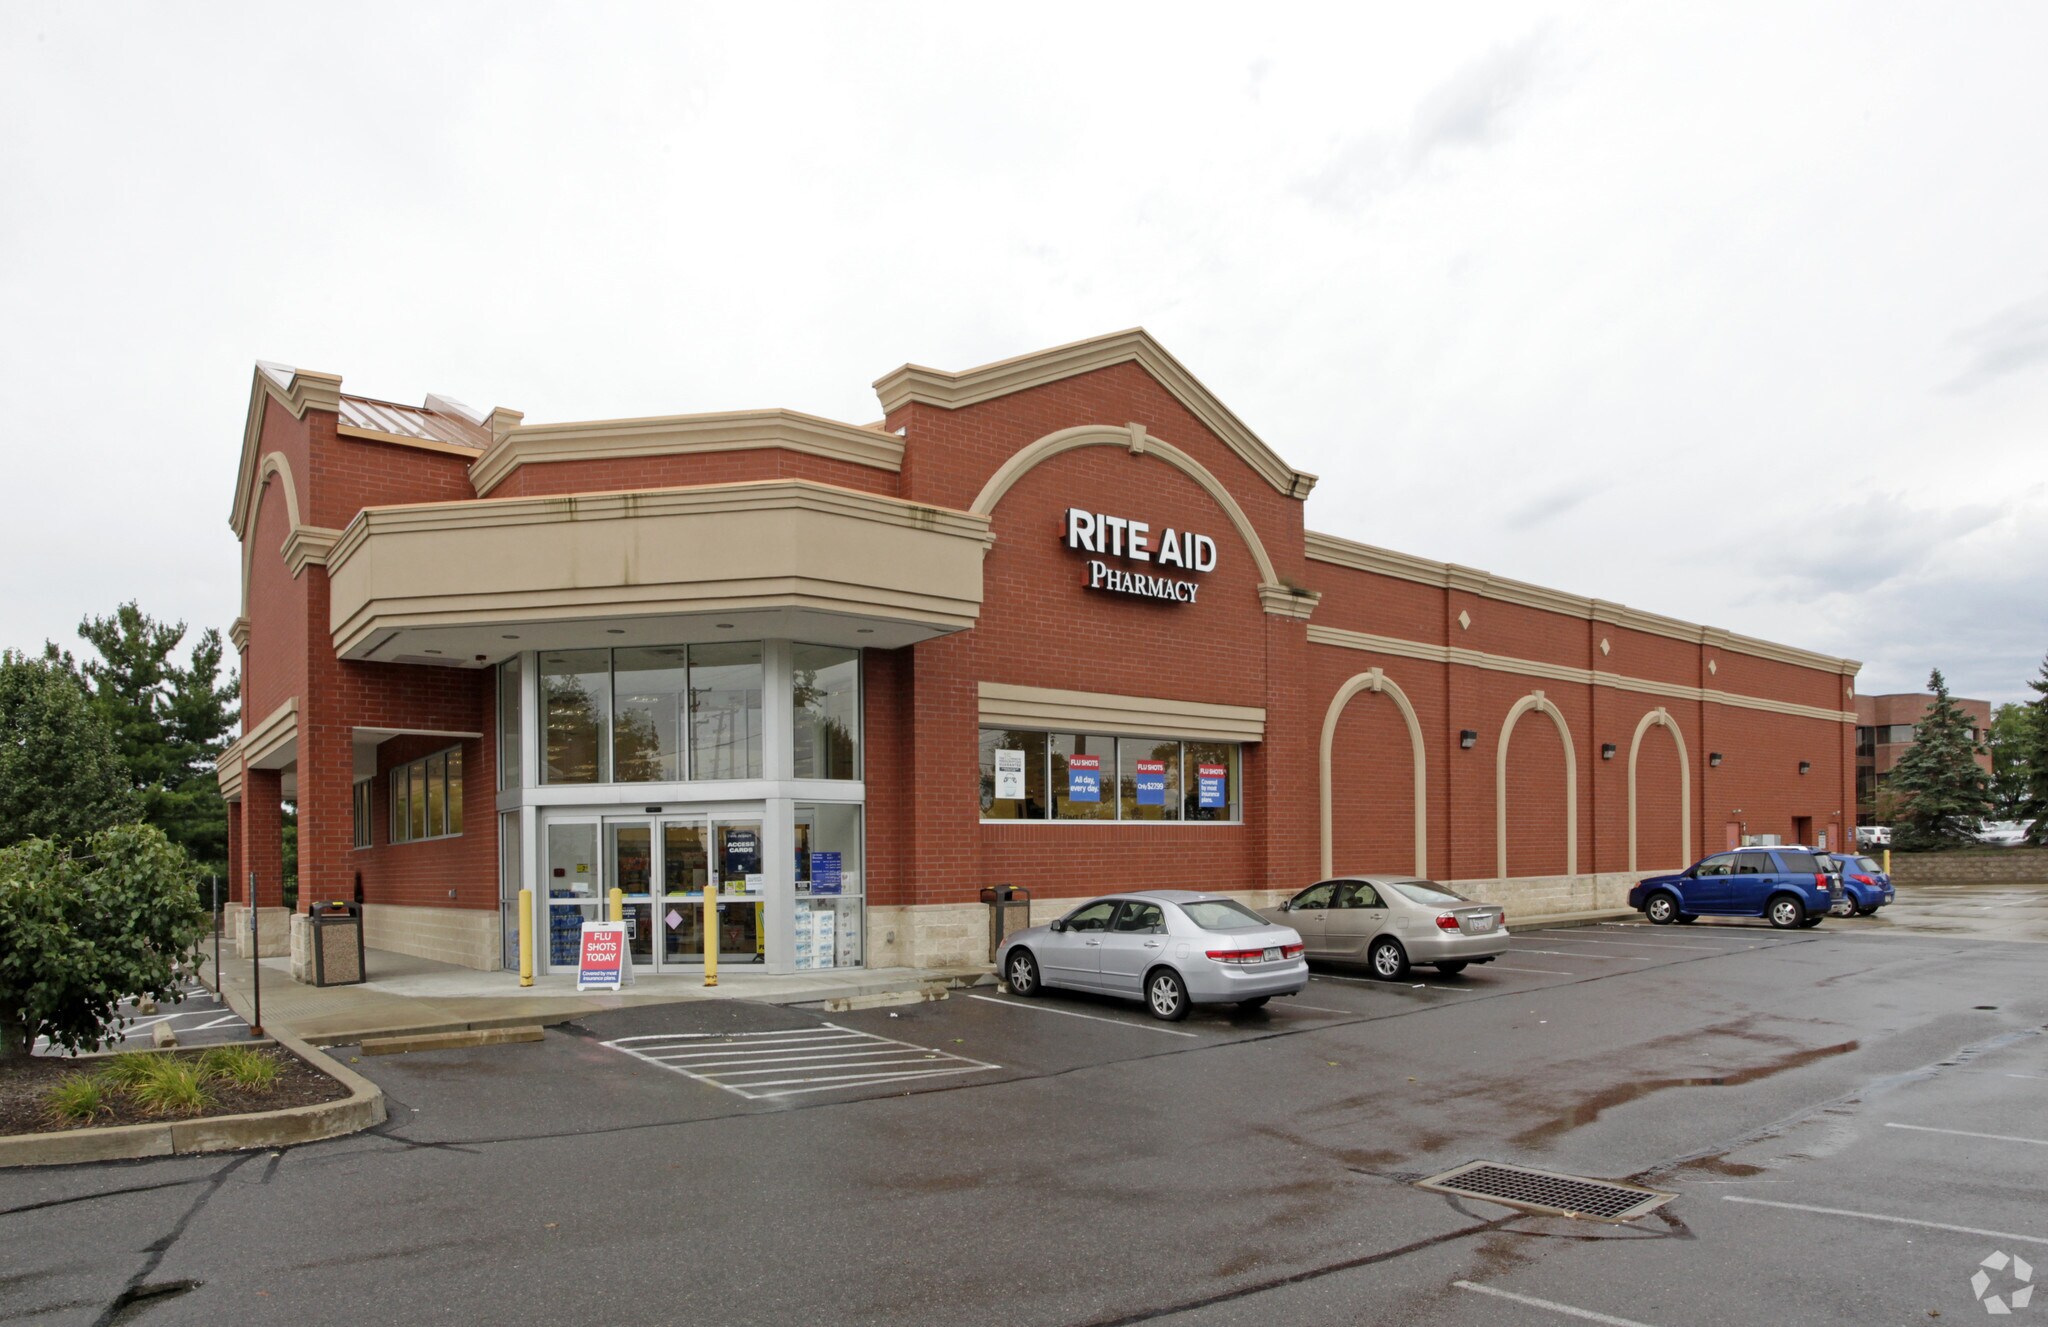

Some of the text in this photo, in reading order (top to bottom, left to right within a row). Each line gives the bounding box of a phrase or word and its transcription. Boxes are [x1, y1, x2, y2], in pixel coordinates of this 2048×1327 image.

[1068, 507, 1218, 573] RITE AID
[1083, 775, 1095, 785] day,
[1070, 785, 1087, 793] every
[1137, 783, 1147, 791] Only
[594, 932, 612, 940] FLU
[587, 943, 617, 951] SHOTS
[586, 953, 616, 962] TODAY
